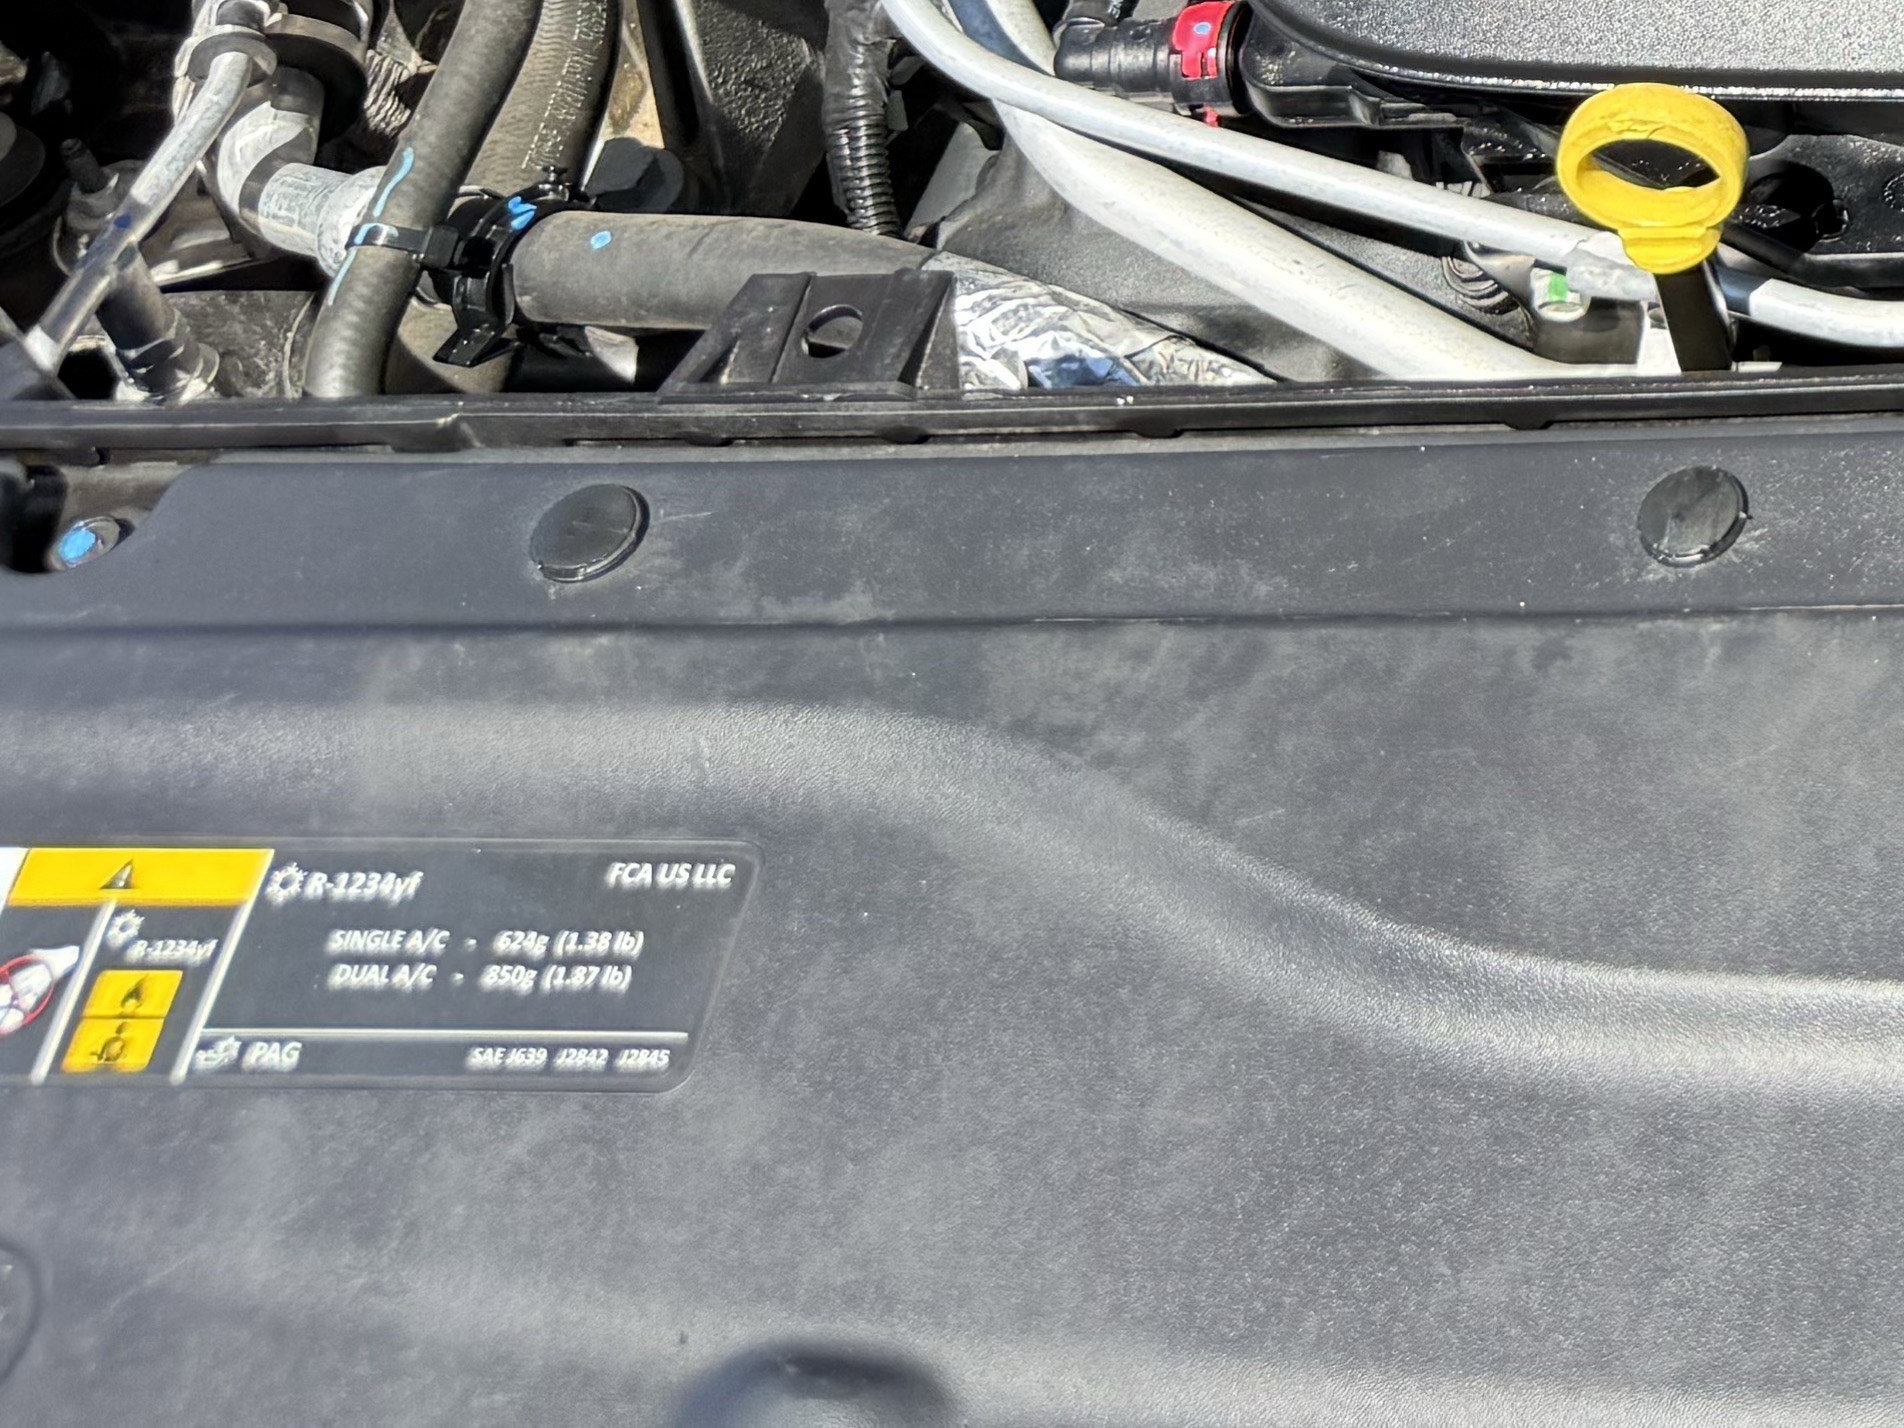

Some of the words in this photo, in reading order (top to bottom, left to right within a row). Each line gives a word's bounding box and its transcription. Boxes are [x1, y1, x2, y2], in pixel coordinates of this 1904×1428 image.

[303, 870, 424, 906] R-1234yf
[607, 861, 653, 889] FCA
[656, 862, 691, 889] US
[692, 863, 736, 890] LLC
[126, 938, 219, 964] R-1234yf
[328, 929, 406, 953] SINGLE
[404, 929, 450, 955] A/C
[493, 931, 551, 960] 624g
[553, 931, 612, 959] (1.38
[612, 931, 645, 961] lb)
[329, 964, 390, 989] DUAL
[394, 964, 438, 991] A/C
[481, 964, 538, 994] 850g
[539, 965, 600, 994] (1.87
[600, 965, 633, 994] lb)
[242, 1041, 303, 1071] PAG
[467, 1048, 504, 1070] SAE
[505, 1048, 548, 1070] J639
[553, 1049, 609, 1072] J2842
[614, 1049, 670, 1072] J2845
